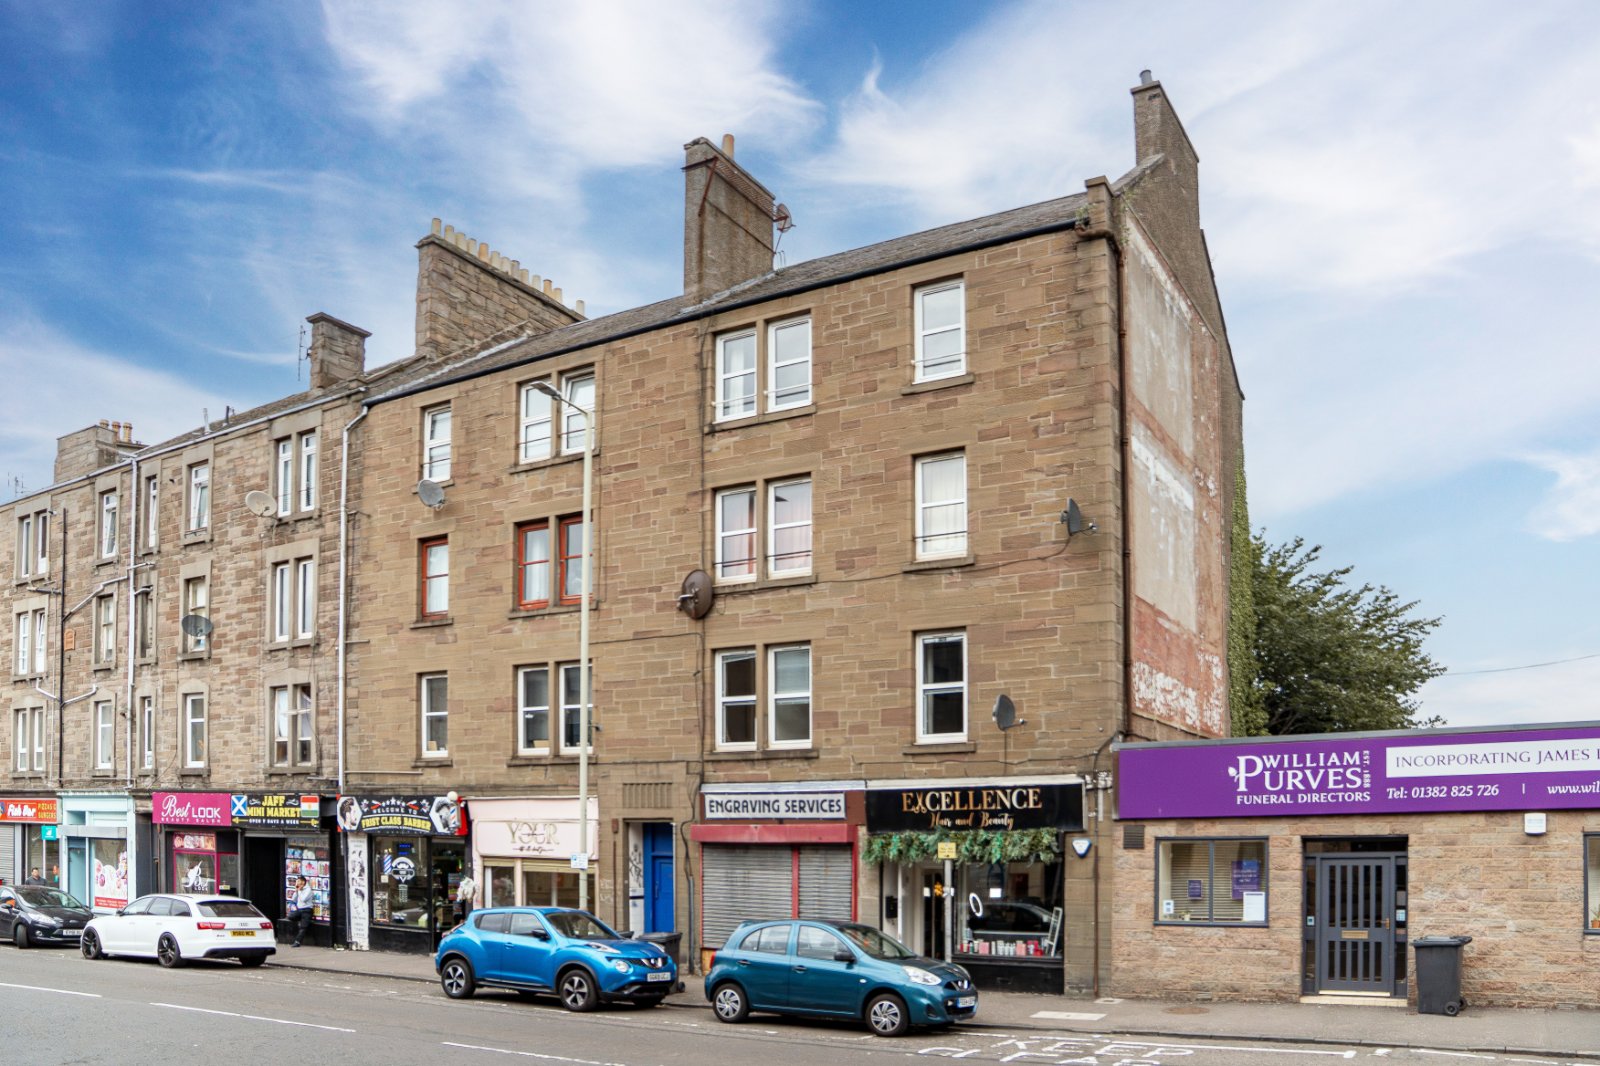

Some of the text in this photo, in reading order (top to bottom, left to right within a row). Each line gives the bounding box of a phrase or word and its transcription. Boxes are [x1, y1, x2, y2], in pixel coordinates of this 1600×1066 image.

[1262, 751, 1361, 769] WILLIAM
[1395, 750, 1531, 768] INCORPORATING
[1535, 748, 1590, 765] JAMES
[1236, 755, 1362, 792] PURVES
[261, 795, 286, 806] JAFF
[902, 788, 1043, 813] EXCELLENCE
[1236, 791, 1371, 805] FUNERAL DIRECTORS
[1386, 787, 1408, 799] Tel:
[1411, 785, 1447, 799] 01382
[1450, 785, 1473, 797] 825
[1477, 784, 1499, 796] 726
[161, 794, 221, 818] Best LOOK
[247, 807, 301, 818] MINI MARKET
[709, 799, 842, 813] ENGRAVING SERVICES
[380, 816, 402, 826] CLASS
[403, 817, 432, 831] BARBER
[930, 812, 1015, 830] Hair and Beauty
[505, 822, 560, 845] YOUR
